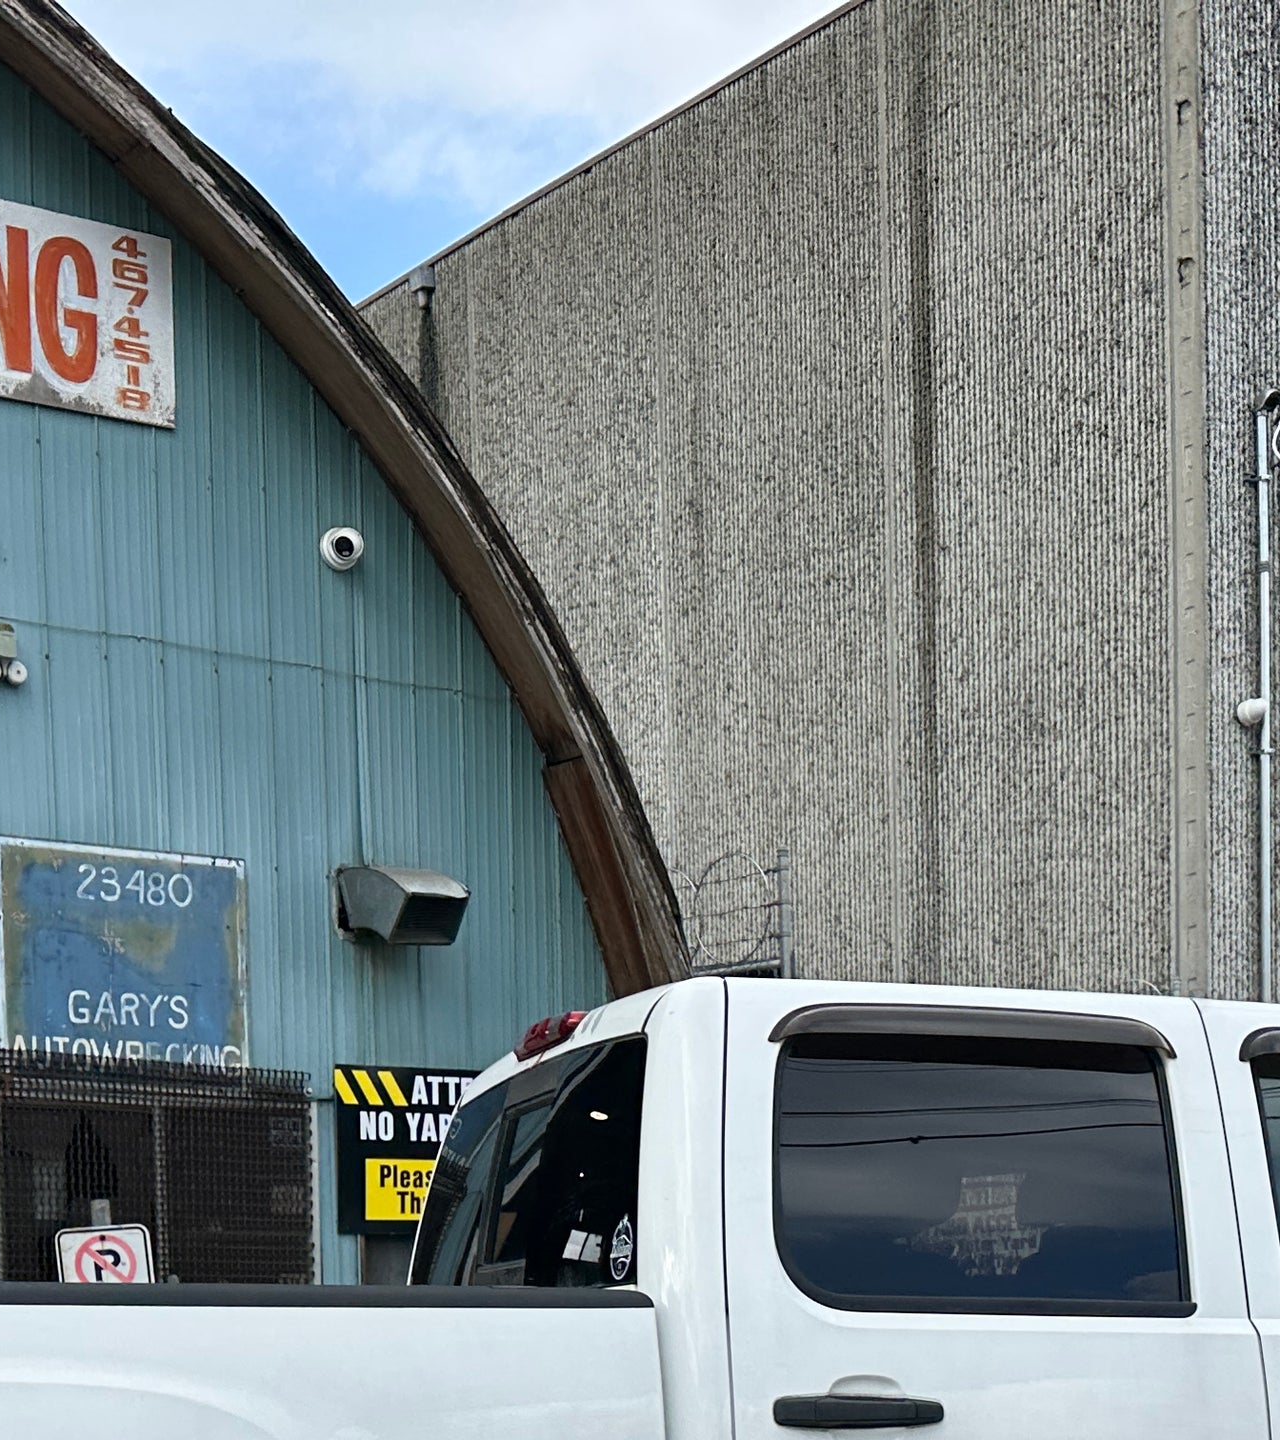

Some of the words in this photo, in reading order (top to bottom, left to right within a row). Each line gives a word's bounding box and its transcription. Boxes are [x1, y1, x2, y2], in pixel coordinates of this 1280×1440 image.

[76, 864, 193, 908] 23480
[68, 989, 189, 1029] GARY'S
[359, 1110, 394, 1141] NO
